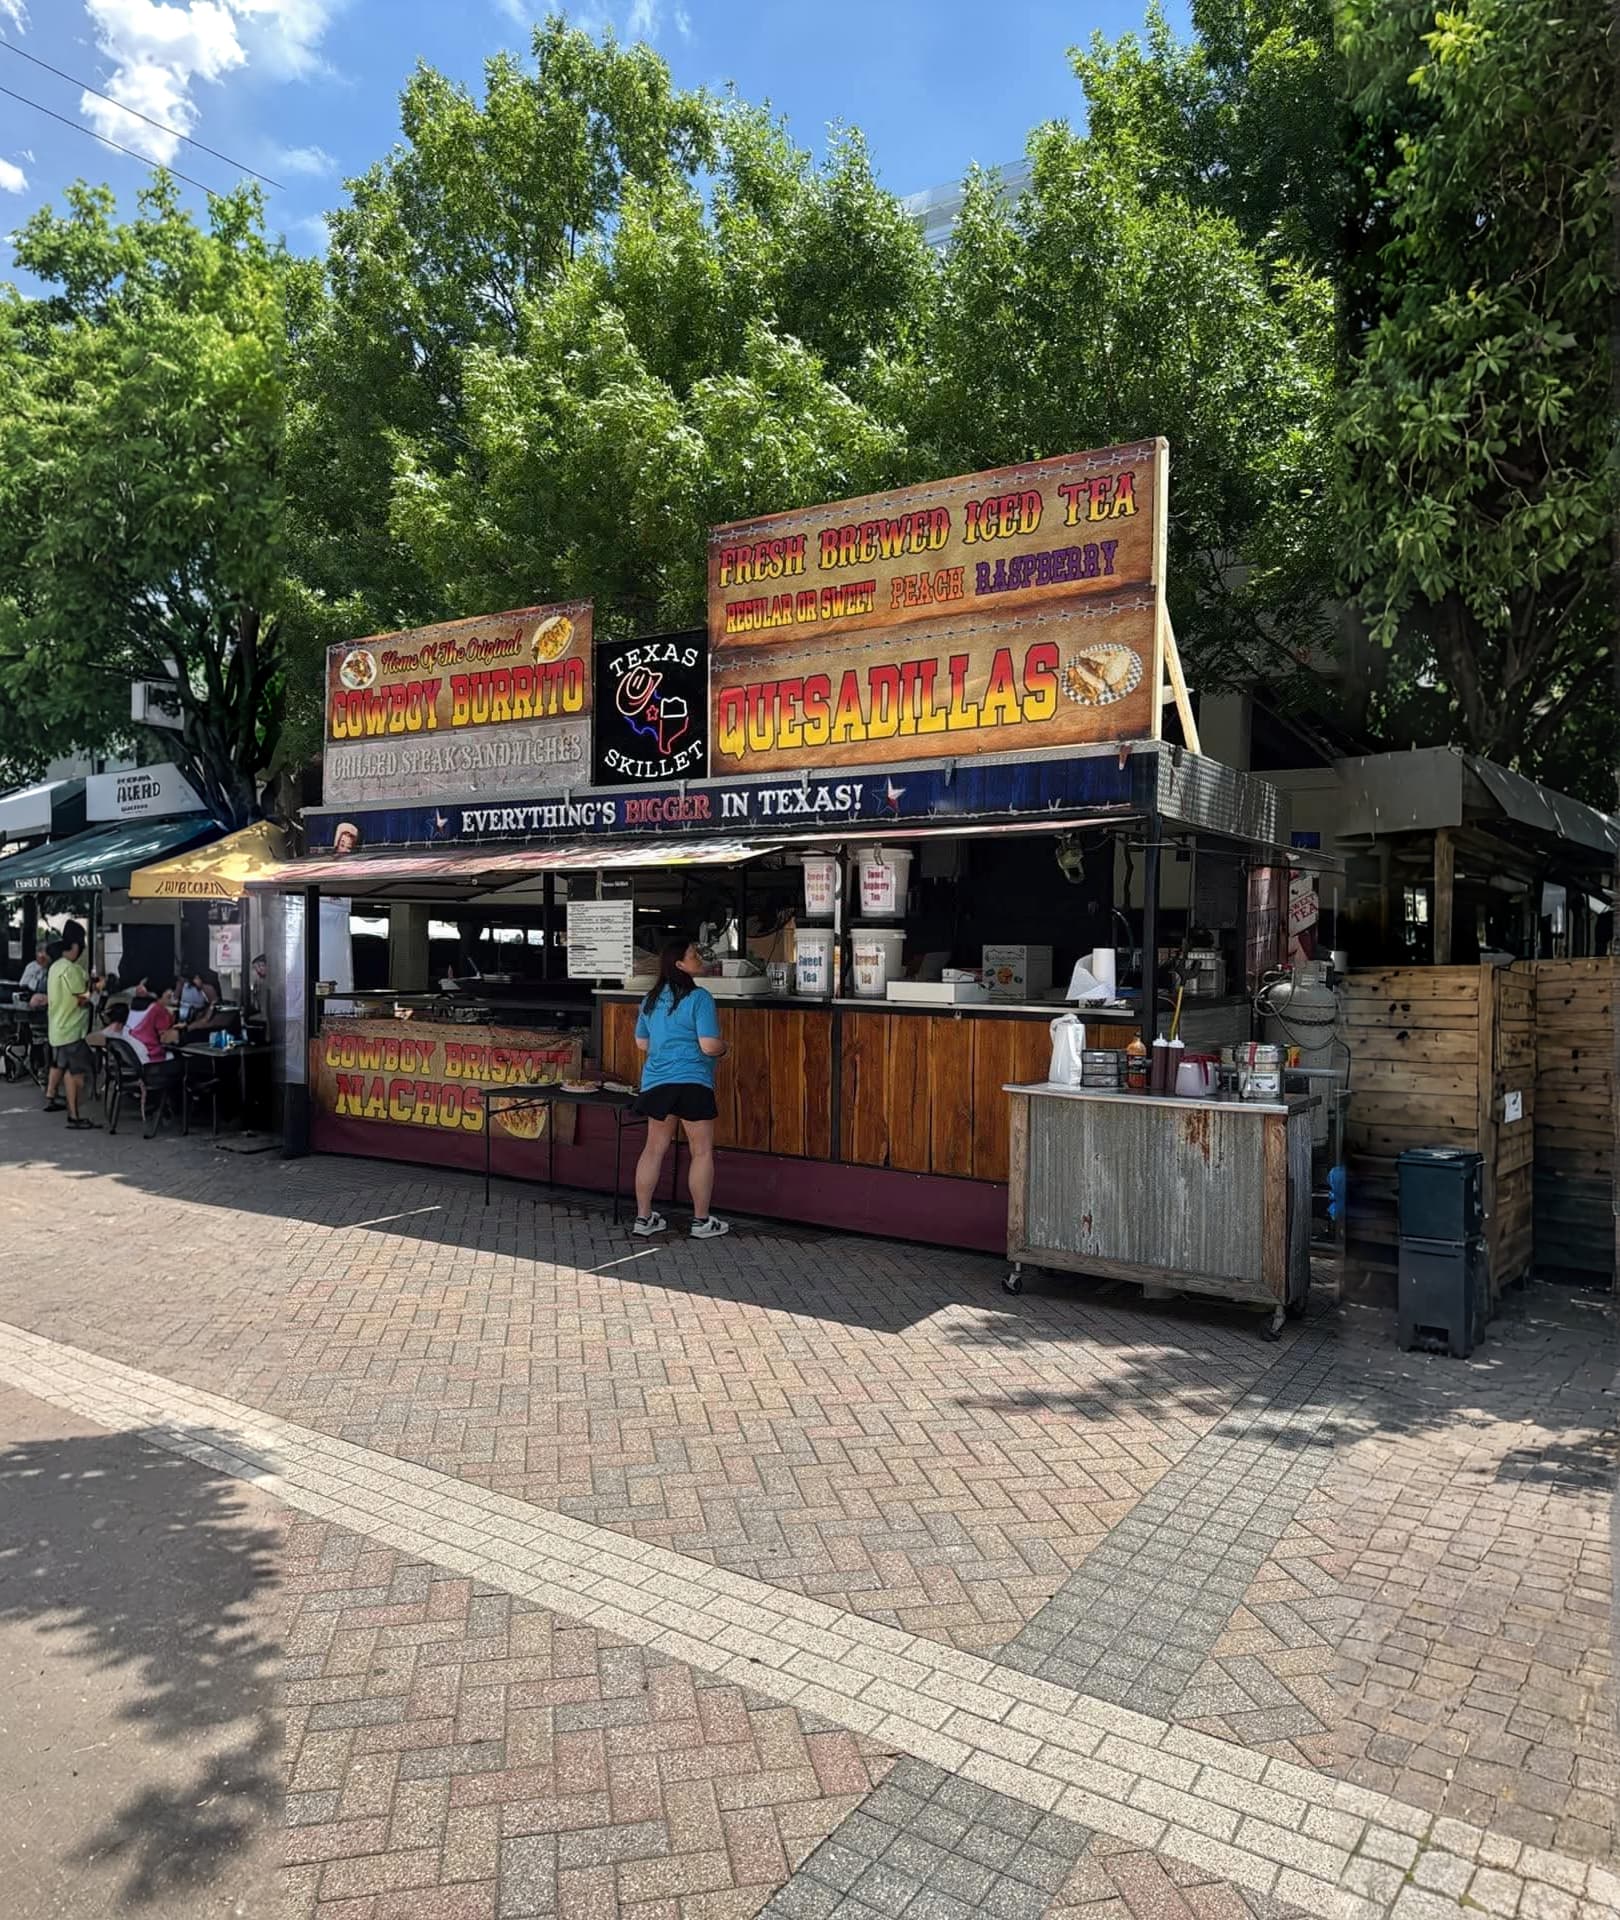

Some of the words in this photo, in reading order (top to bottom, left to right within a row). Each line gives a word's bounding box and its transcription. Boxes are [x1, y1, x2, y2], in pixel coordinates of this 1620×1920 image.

[718, 534, 807, 588] FRESH
[818, 506, 951, 570] BREWED
[963, 489, 1044, 544] ICED
[1058, 471, 1139, 527] TEA
[725, 593, 794, 633] REGULAR
[795, 589, 817, 623] OR
[820, 579, 876, 620] SWEET
[890, 566, 965, 609] PEACH
[975, 539, 1118, 596] RASPBERRY
[381, 651, 418, 675] Home
[420, 646, 436, 673] Of
[435, 640, 465, 666] The
[466, 628, 522, 665] Original
[609, 643, 699, 677] TEXAS
[332, 678, 442, 739] COWBOY
[450, 657, 585, 727] BURRITO
[718, 642, 1060, 761] QUESADILLAS
[332, 750, 397, 780] GRILLED
[400, 744, 457, 775] STEAK
[461, 735, 583, 769] SANDWICHES
[604, 740, 704, 777] SKILLET
[461, 801, 616, 833] EVERYTHING'S
[624, 794, 711, 824] BIGGER
[720, 791, 750, 818] IN
[757, 784, 864, 816] TEXAS!
[803, 971, 817, 983] Tea
[325, 1034, 437, 1075] COWBOY
[444, 1041, 573, 1085] BRISKET
[335, 1073, 486, 1132] NACHOS
